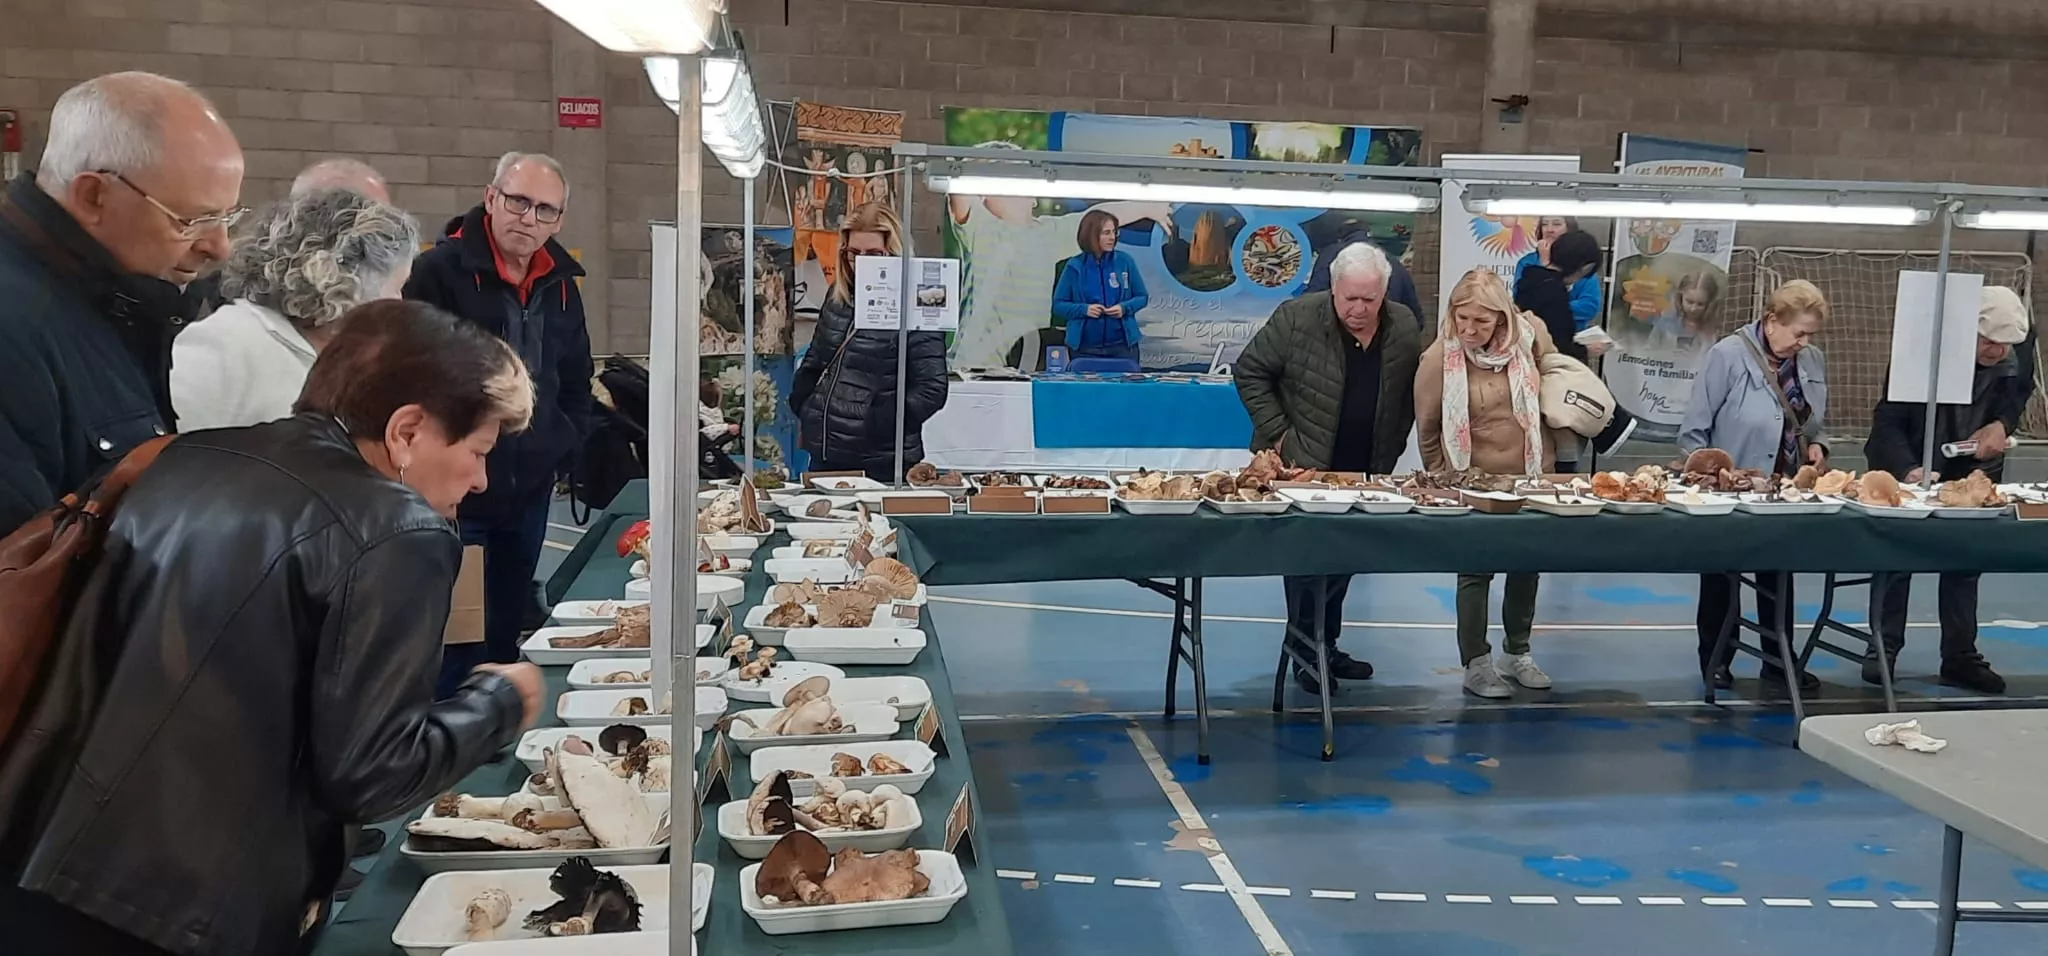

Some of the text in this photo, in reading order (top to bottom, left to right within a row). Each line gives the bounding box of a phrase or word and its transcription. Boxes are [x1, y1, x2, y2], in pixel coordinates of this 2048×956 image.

[560, 102, 600, 115] CELIACOS
[1655, 165, 1724, 177] AVENTURAS
[1618, 353, 1674, 369] ¡Emociones
[1643, 368, 1656, 376] en
[1639, 380, 1670, 413] hoya
